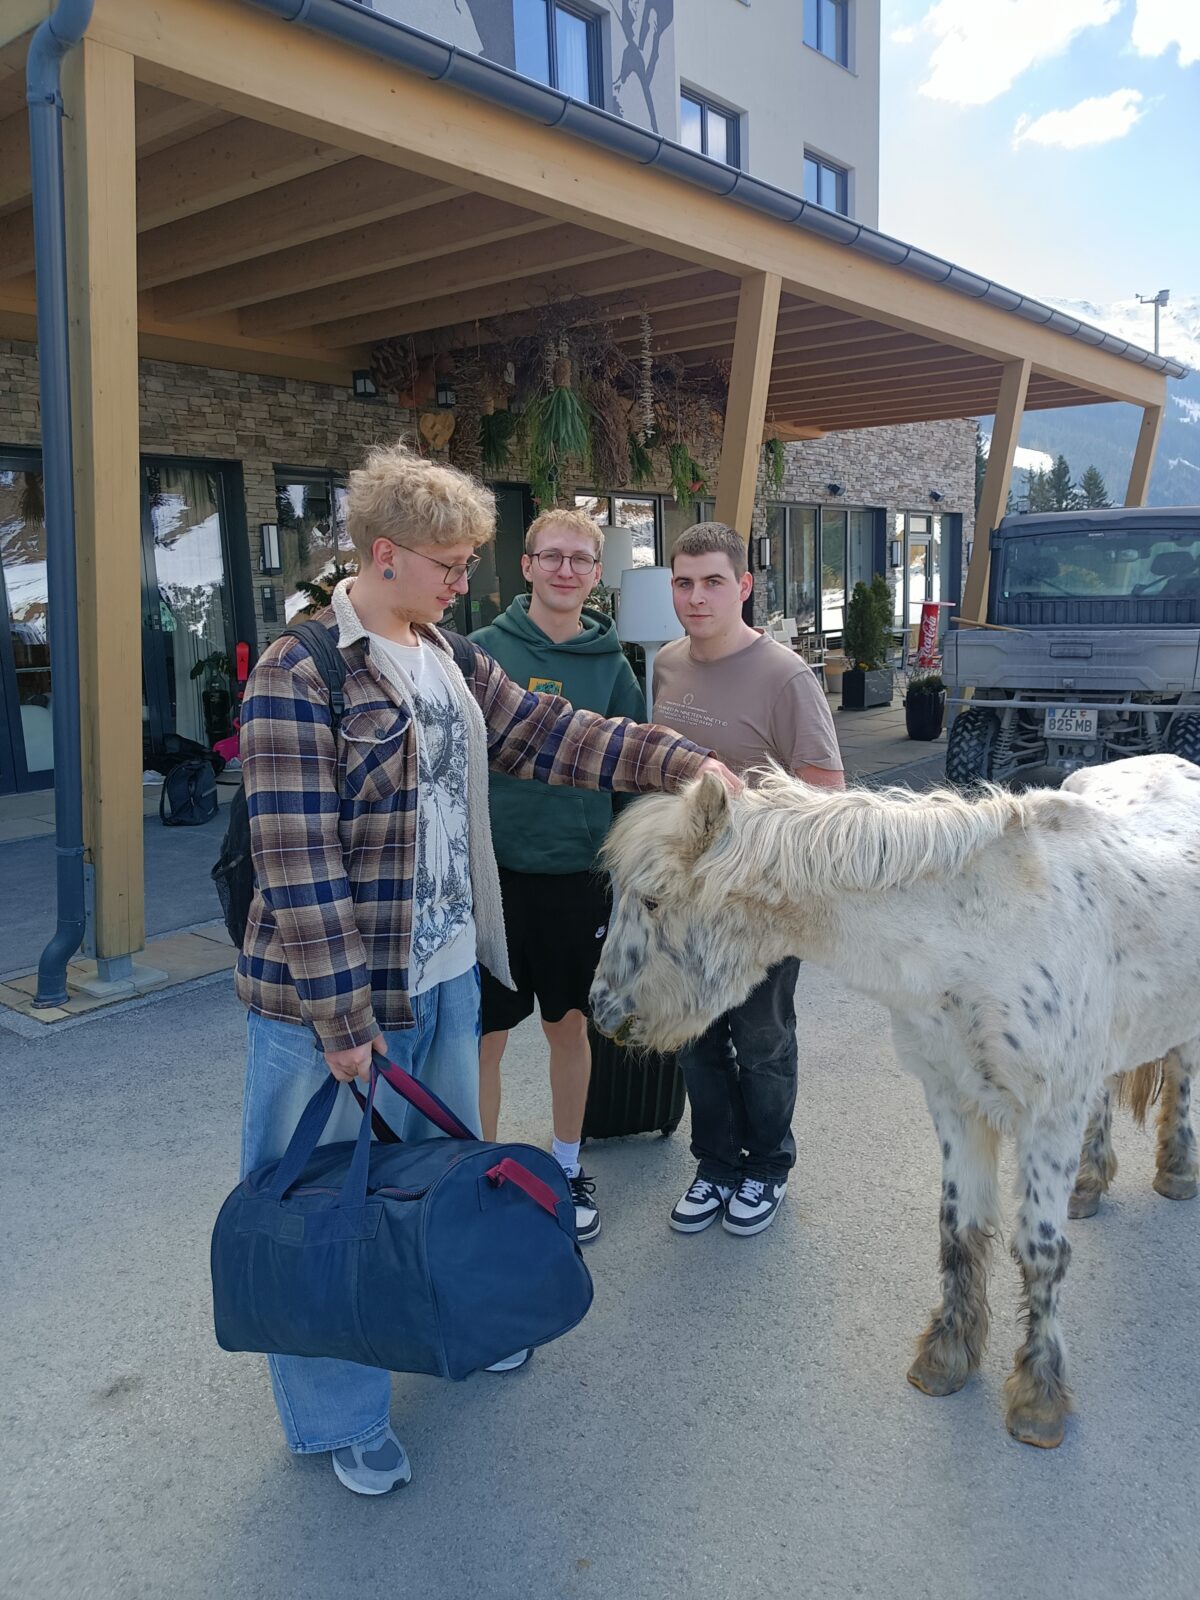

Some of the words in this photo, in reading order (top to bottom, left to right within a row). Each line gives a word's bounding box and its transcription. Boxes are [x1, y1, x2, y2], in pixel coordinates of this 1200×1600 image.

[1061, 708, 1077, 719] ZE
[1048, 718, 1073, 731] 825
[1074, 719, 1093, 732] MB
